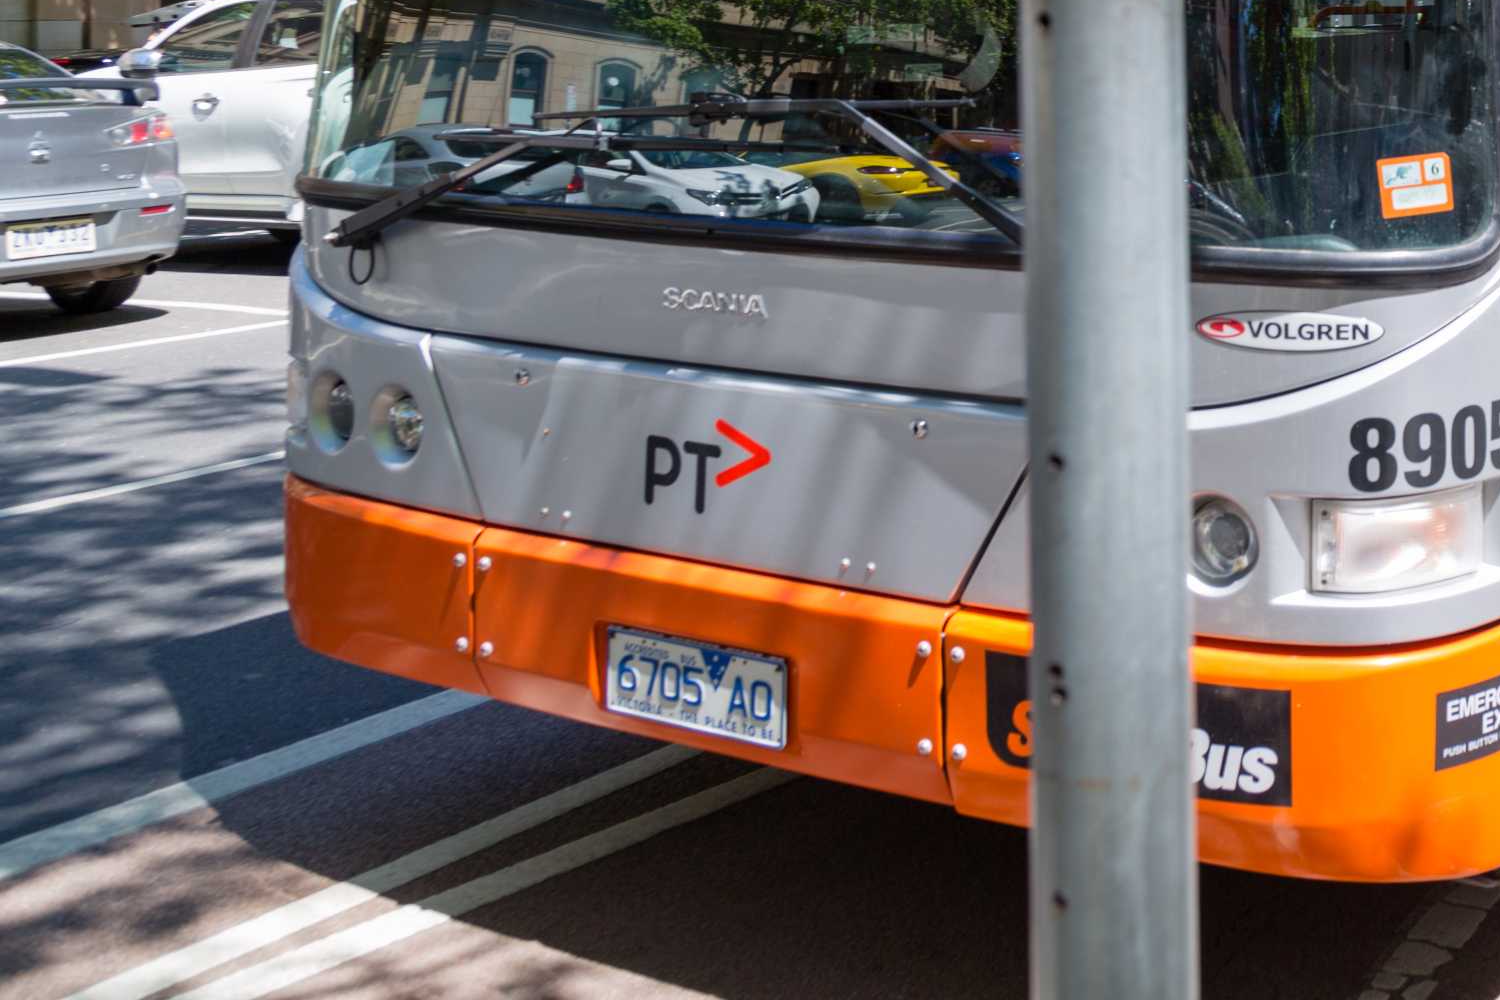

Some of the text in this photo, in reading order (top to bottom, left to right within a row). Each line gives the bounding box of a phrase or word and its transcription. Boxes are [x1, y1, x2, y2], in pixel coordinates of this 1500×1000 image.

[663, 287, 769, 318] SCANIA
[1248, 320, 1370, 342] VOLGREN
[617, 654, 705, 707] 6705
[704, 715, 738, 733] PLACE
[742, 722, 756, 736] TO
[761, 728, 774, 741] BE
[1467, 731, 1499, 751] BUTTON
